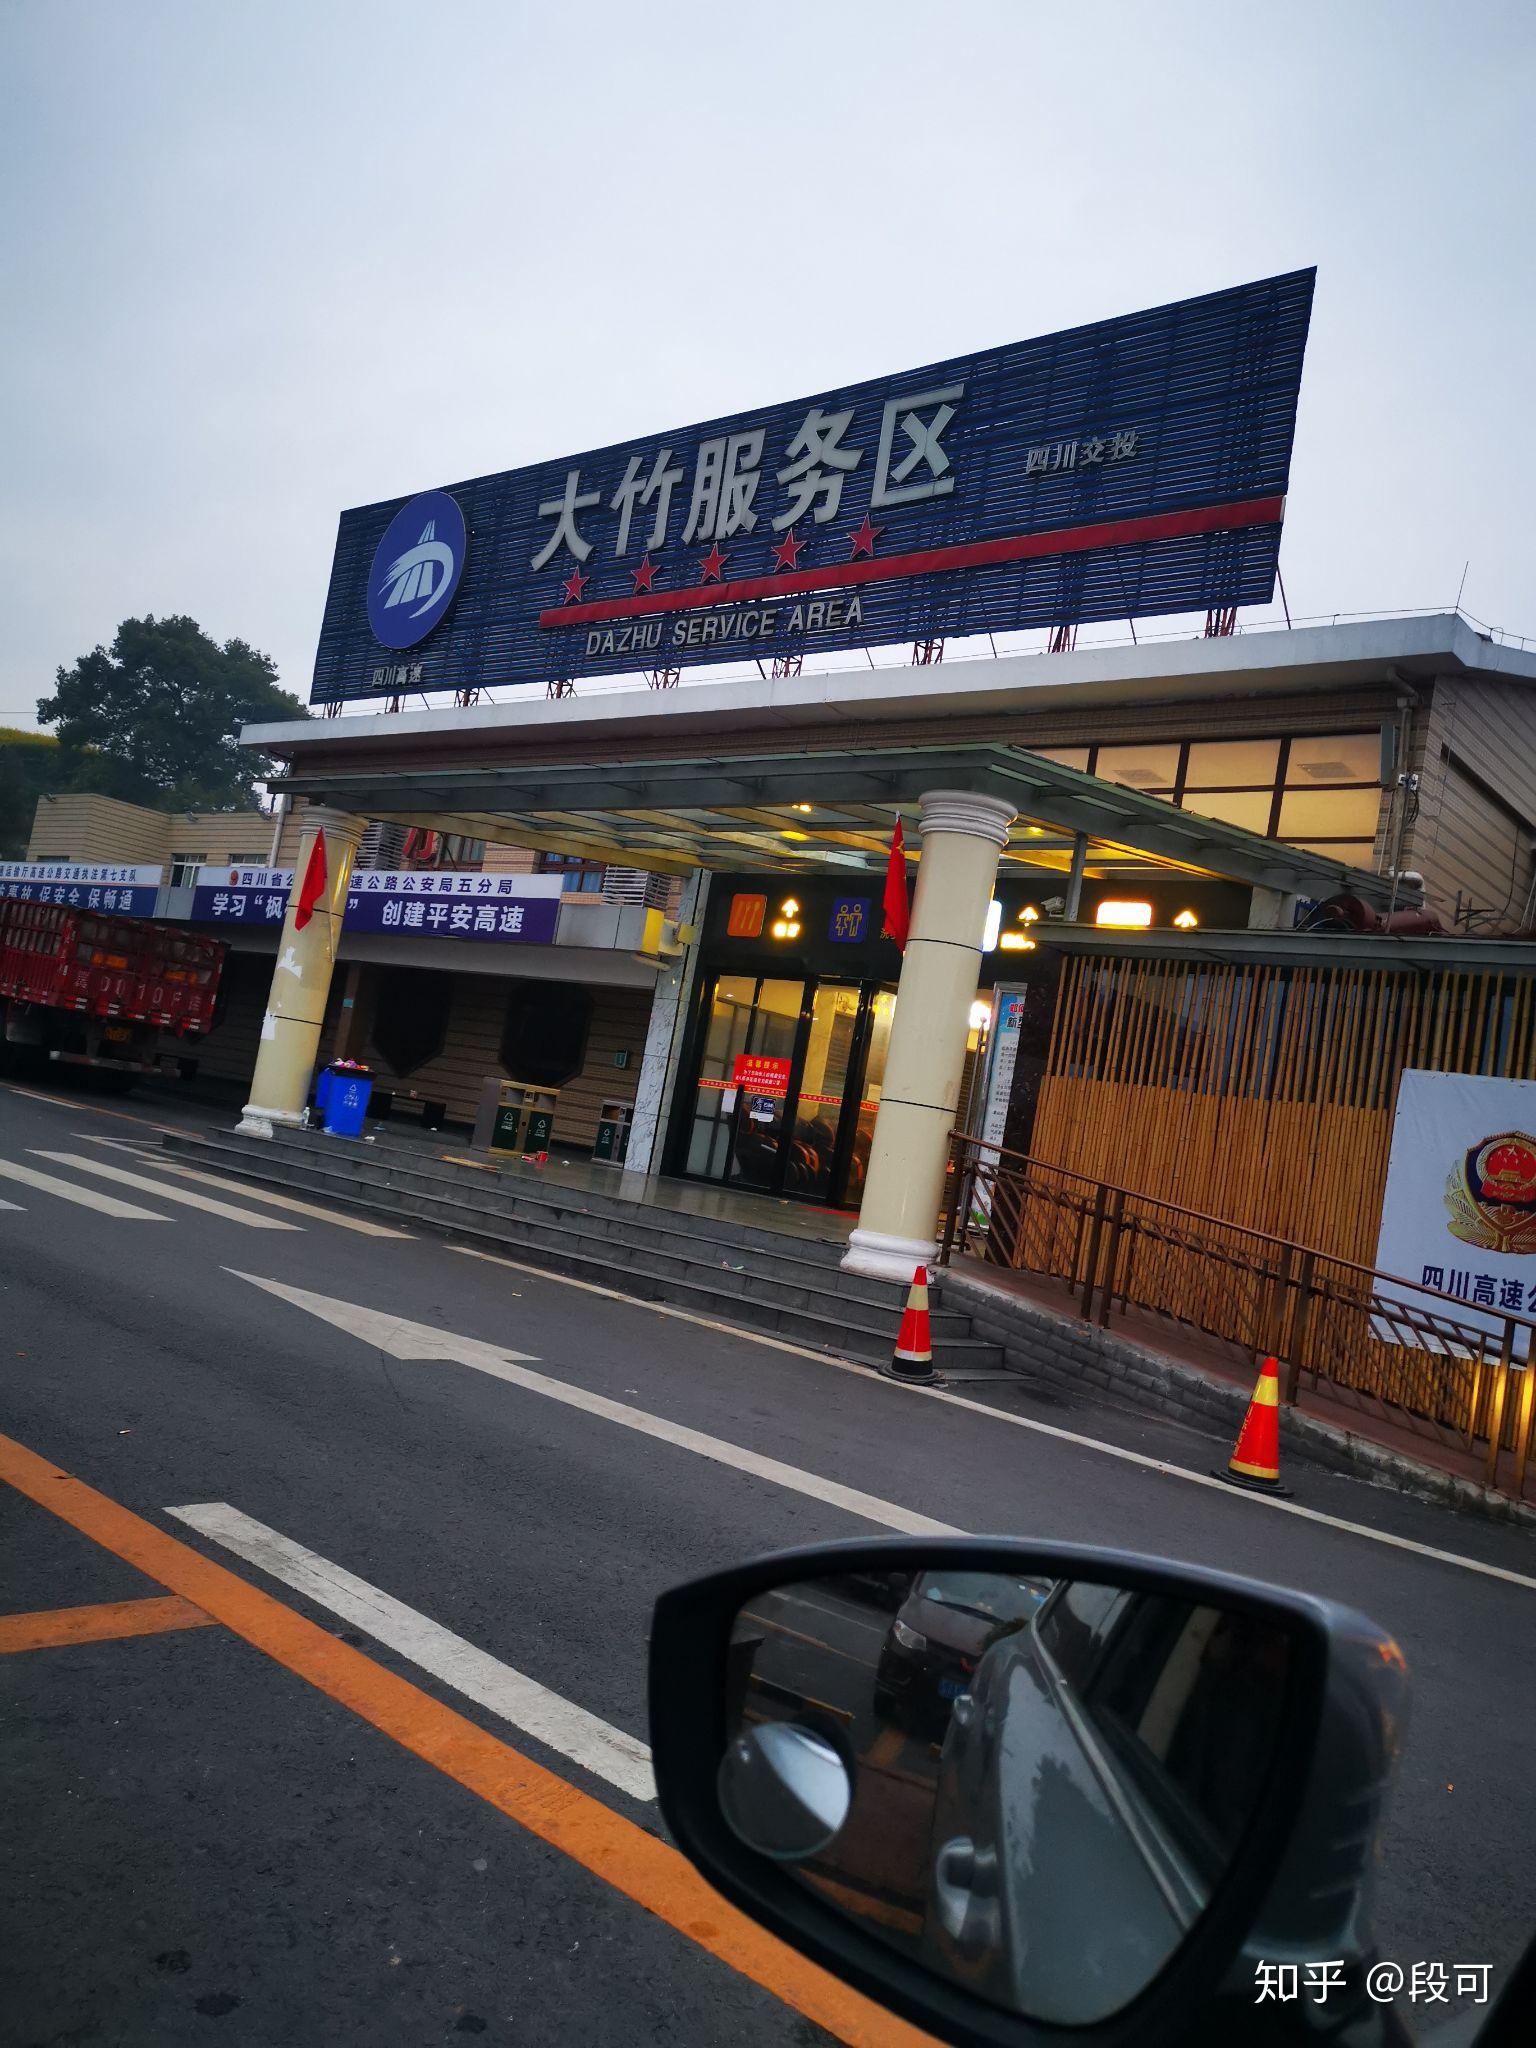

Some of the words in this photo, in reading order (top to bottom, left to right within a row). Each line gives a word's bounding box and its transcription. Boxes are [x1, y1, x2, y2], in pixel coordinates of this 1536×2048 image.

[1025, 430, 1139, 473] 四川交投
[530, 383, 965, 572] 大竹服务区
[585, 622, 662, 656] DAZHU
[672, 608, 777, 646] SERVICE
[787, 596, 865, 632] AREA
[371, 664, 423, 687] 四川高速
[88, 888, 134, 911] 保畅通
[381, 900, 525, 933] 创建平安高速
